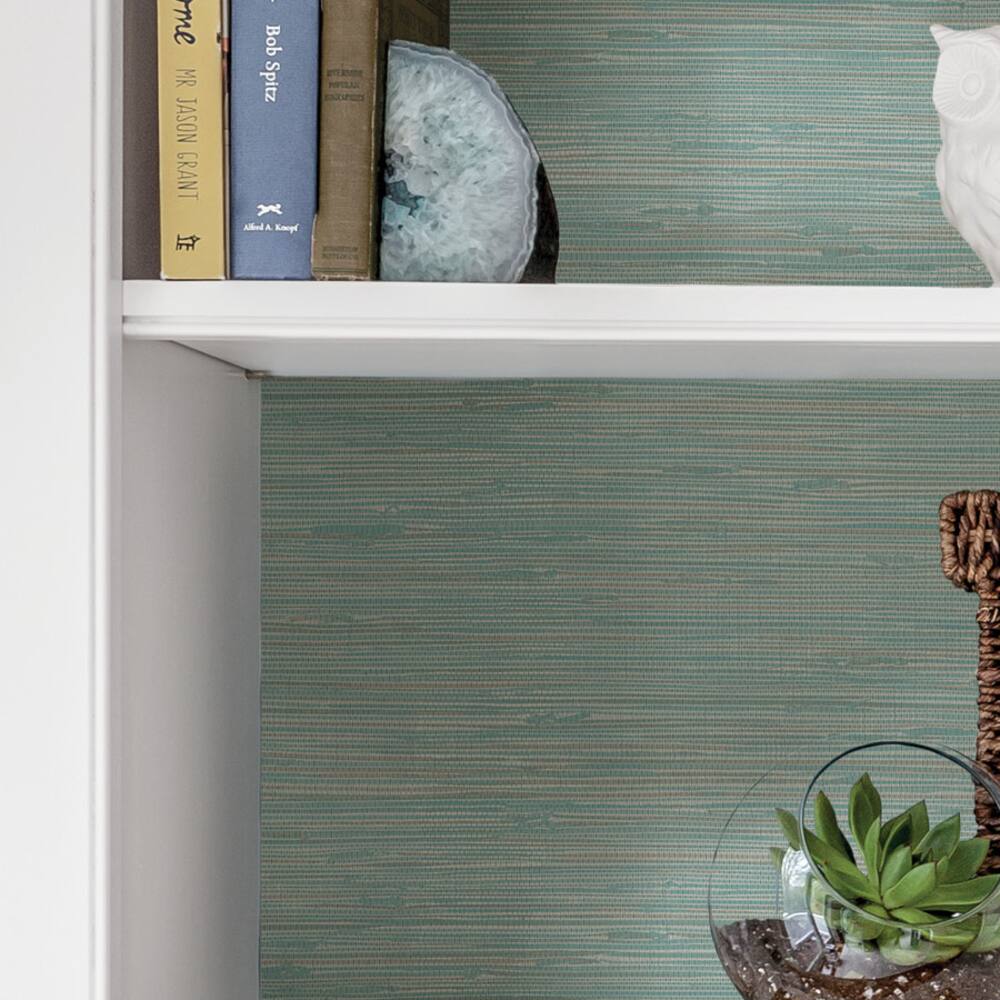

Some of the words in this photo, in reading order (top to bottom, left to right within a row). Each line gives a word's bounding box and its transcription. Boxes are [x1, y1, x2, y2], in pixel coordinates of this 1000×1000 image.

[264, 25, 283, 56] Bob
[175, 69, 197, 88] MR
[259, 60, 281, 102] Spitz
[175, 98, 198, 144] JASON
[176, 151, 199, 200] GRANT
[243, 223, 264, 232] Alfred
[265, 223, 273, 232] A.
[274, 223, 299, 234] Knopf
